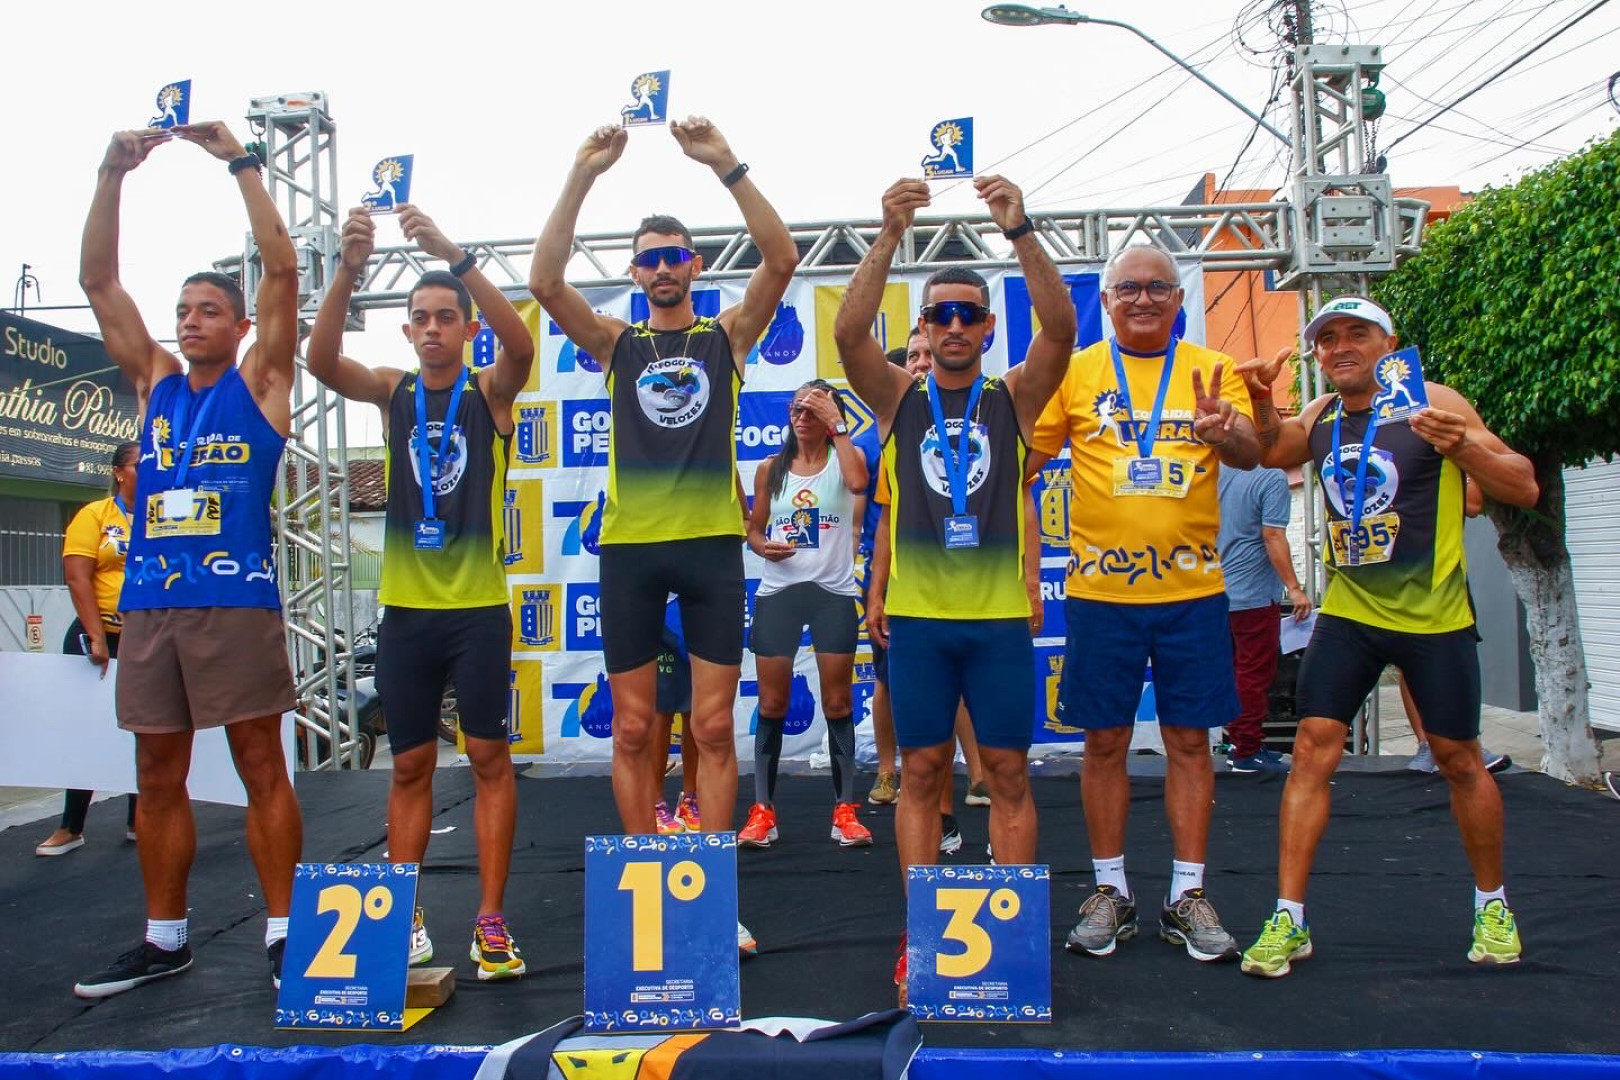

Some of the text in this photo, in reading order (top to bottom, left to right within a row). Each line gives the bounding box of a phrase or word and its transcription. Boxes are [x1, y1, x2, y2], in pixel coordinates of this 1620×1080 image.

[4, 326, 68, 370] Studio
[63, 380, 140, 441] Passos
[572, 411, 611, 432] GO
[659, 401, 703, 425] VELOZES
[573, 433, 610, 453] PE
[588, 723, 611, 731] ANO
[785, 718, 809, 728] NOS
[303, 883, 394, 979] 2º
[618, 859, 706, 972] 1º
[935, 887, 1021, 978] 3º
